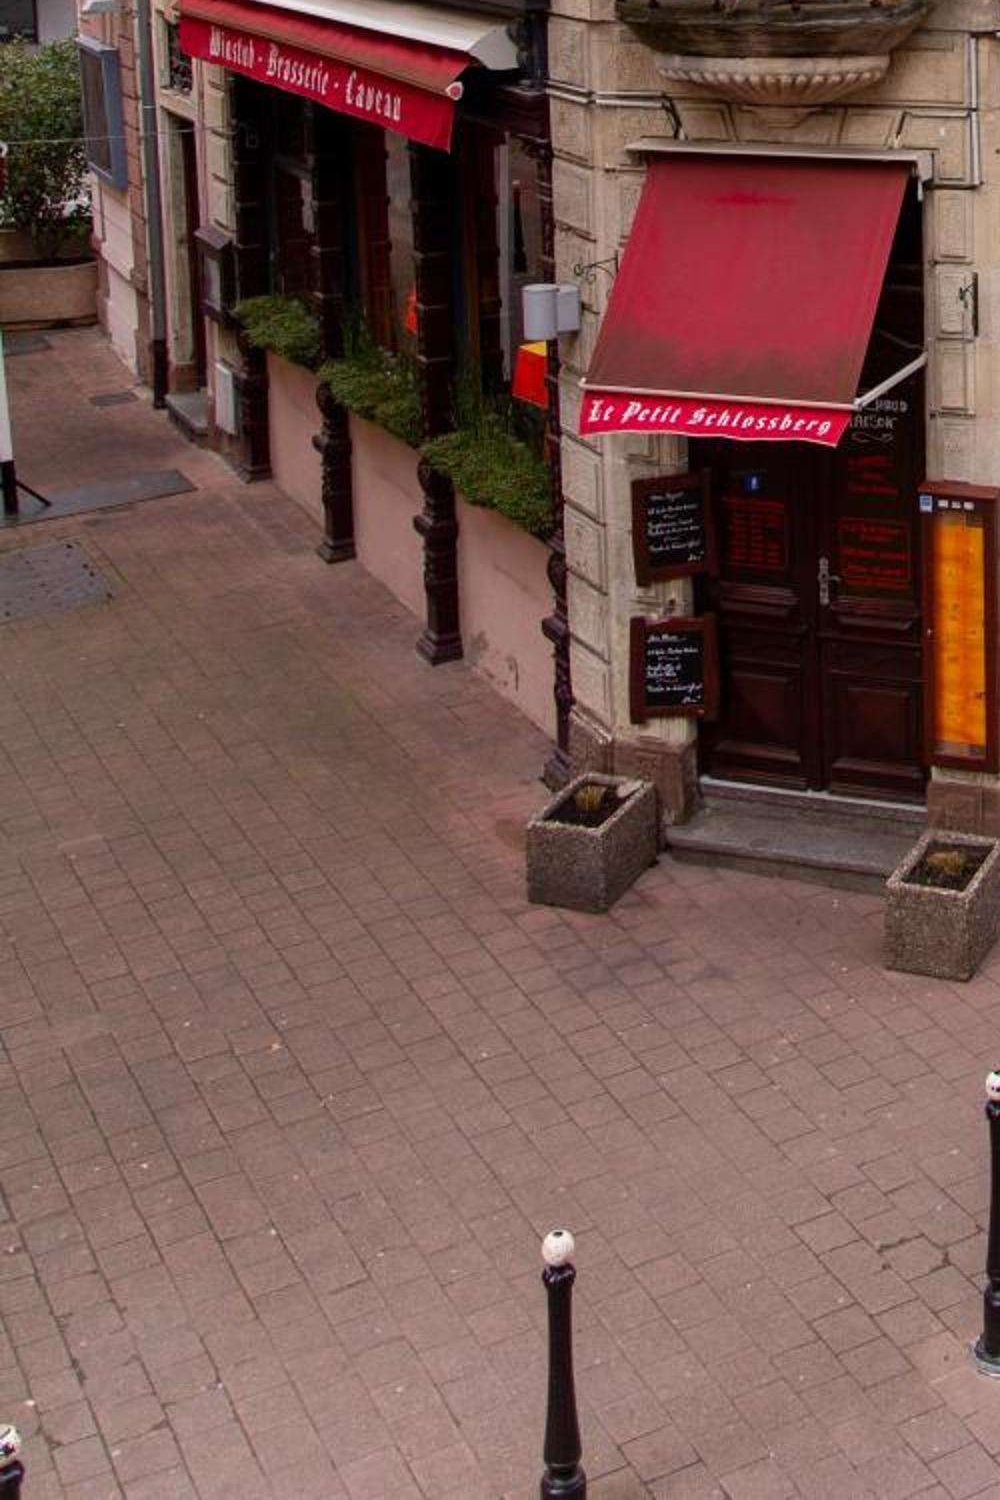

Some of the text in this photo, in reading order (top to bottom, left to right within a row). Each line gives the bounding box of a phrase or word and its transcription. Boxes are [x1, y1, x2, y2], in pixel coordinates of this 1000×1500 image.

[209, 25, 255, 69] Winstub
[266, 42, 329, 96] Brasserie
[345, 70, 401, 121] Caveau
[587, 399, 833, 435] Le Petit Schlossberg
